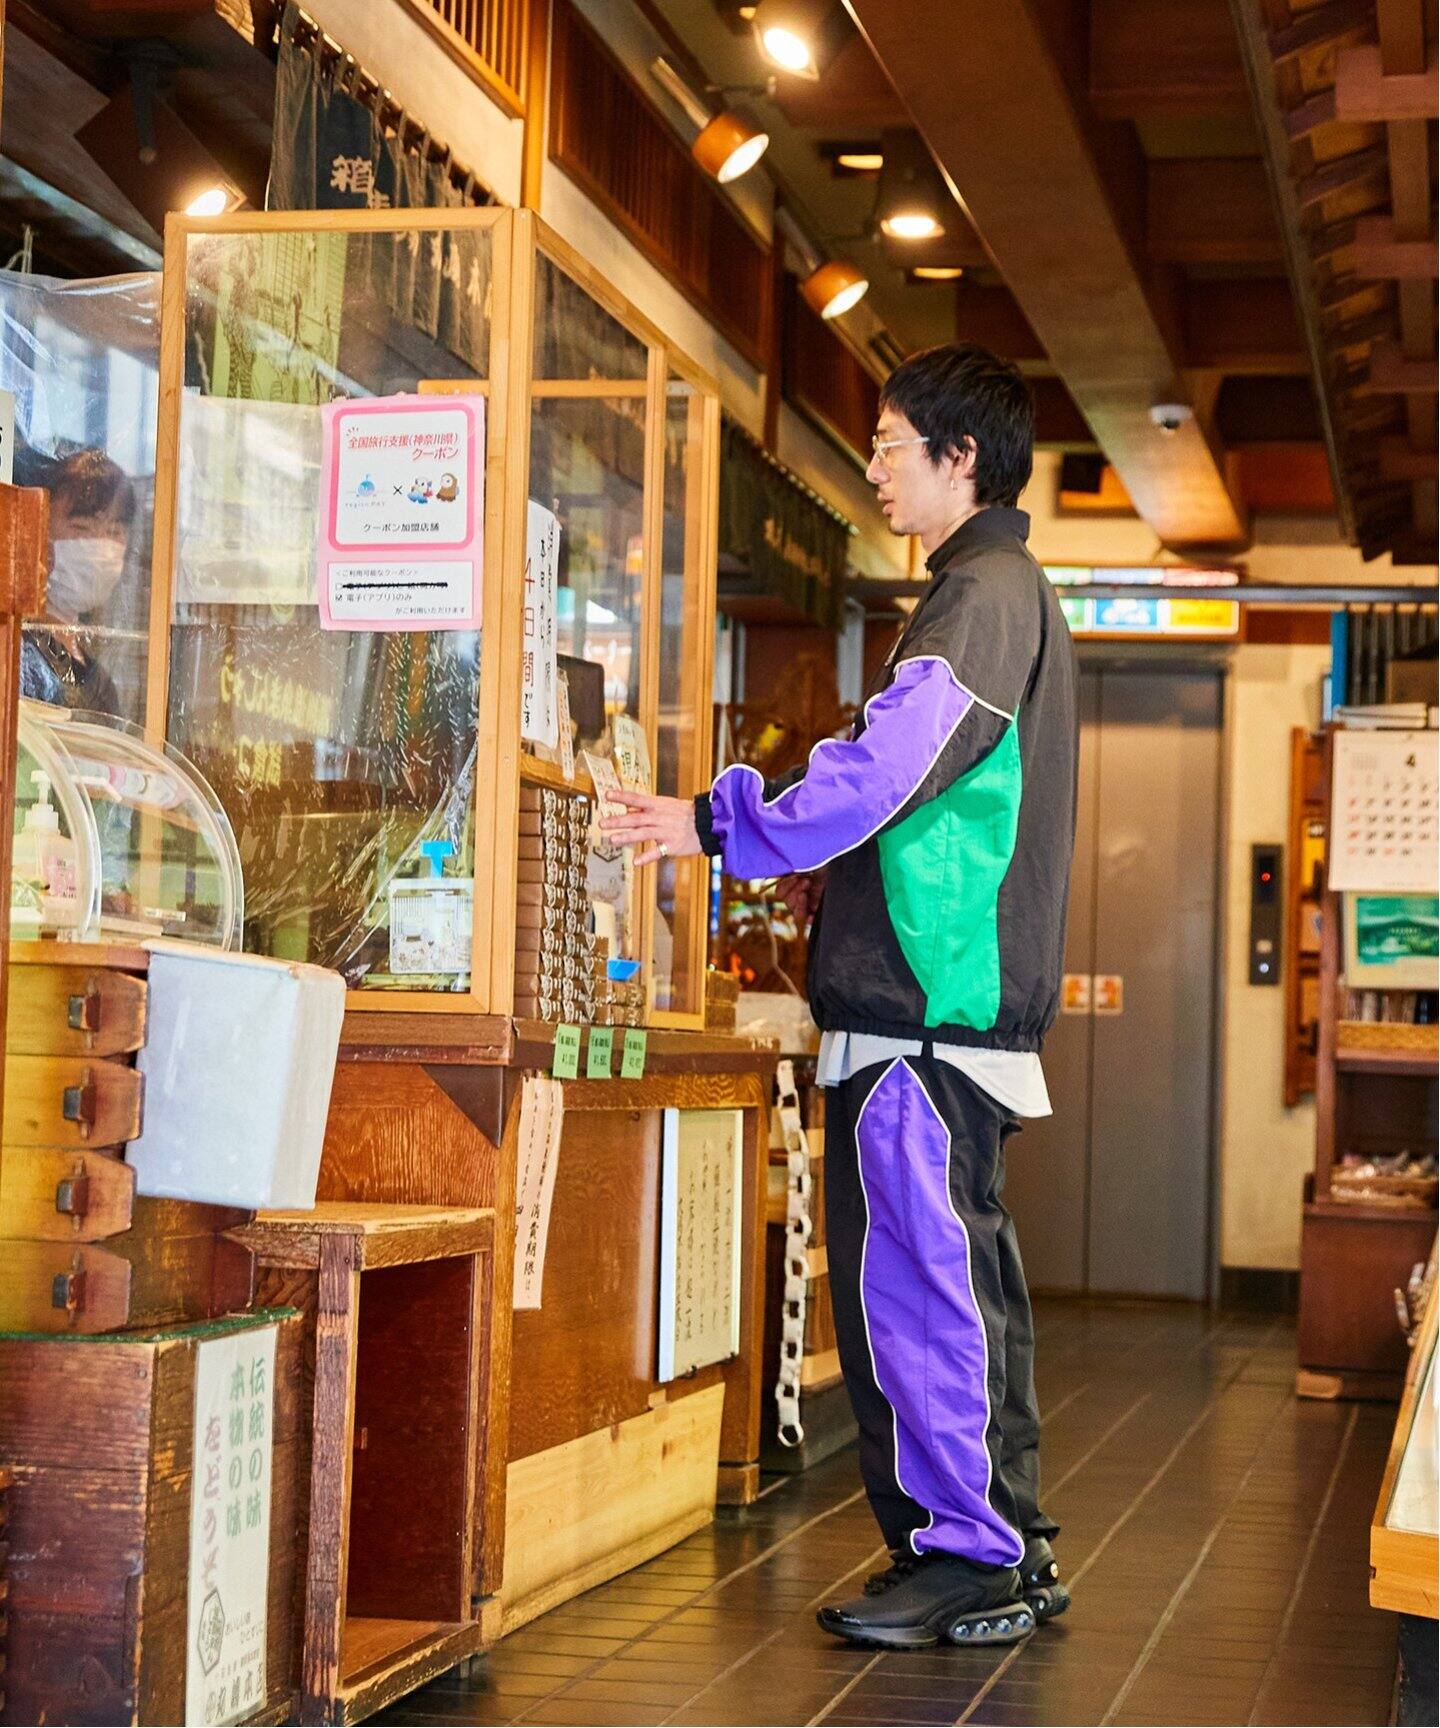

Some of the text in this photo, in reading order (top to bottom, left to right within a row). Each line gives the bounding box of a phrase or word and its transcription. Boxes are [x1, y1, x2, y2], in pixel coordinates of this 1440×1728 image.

[347, 432, 458, 449] 全国旅行支援(神奈川県)
[412, 447, 459, 461] クーポン
[363, 522, 440, 533] クーポン加盟店舗
[227, 1361, 245, 1538] 本物の味
[246, 1357, 265, 1529] 伝統の味
